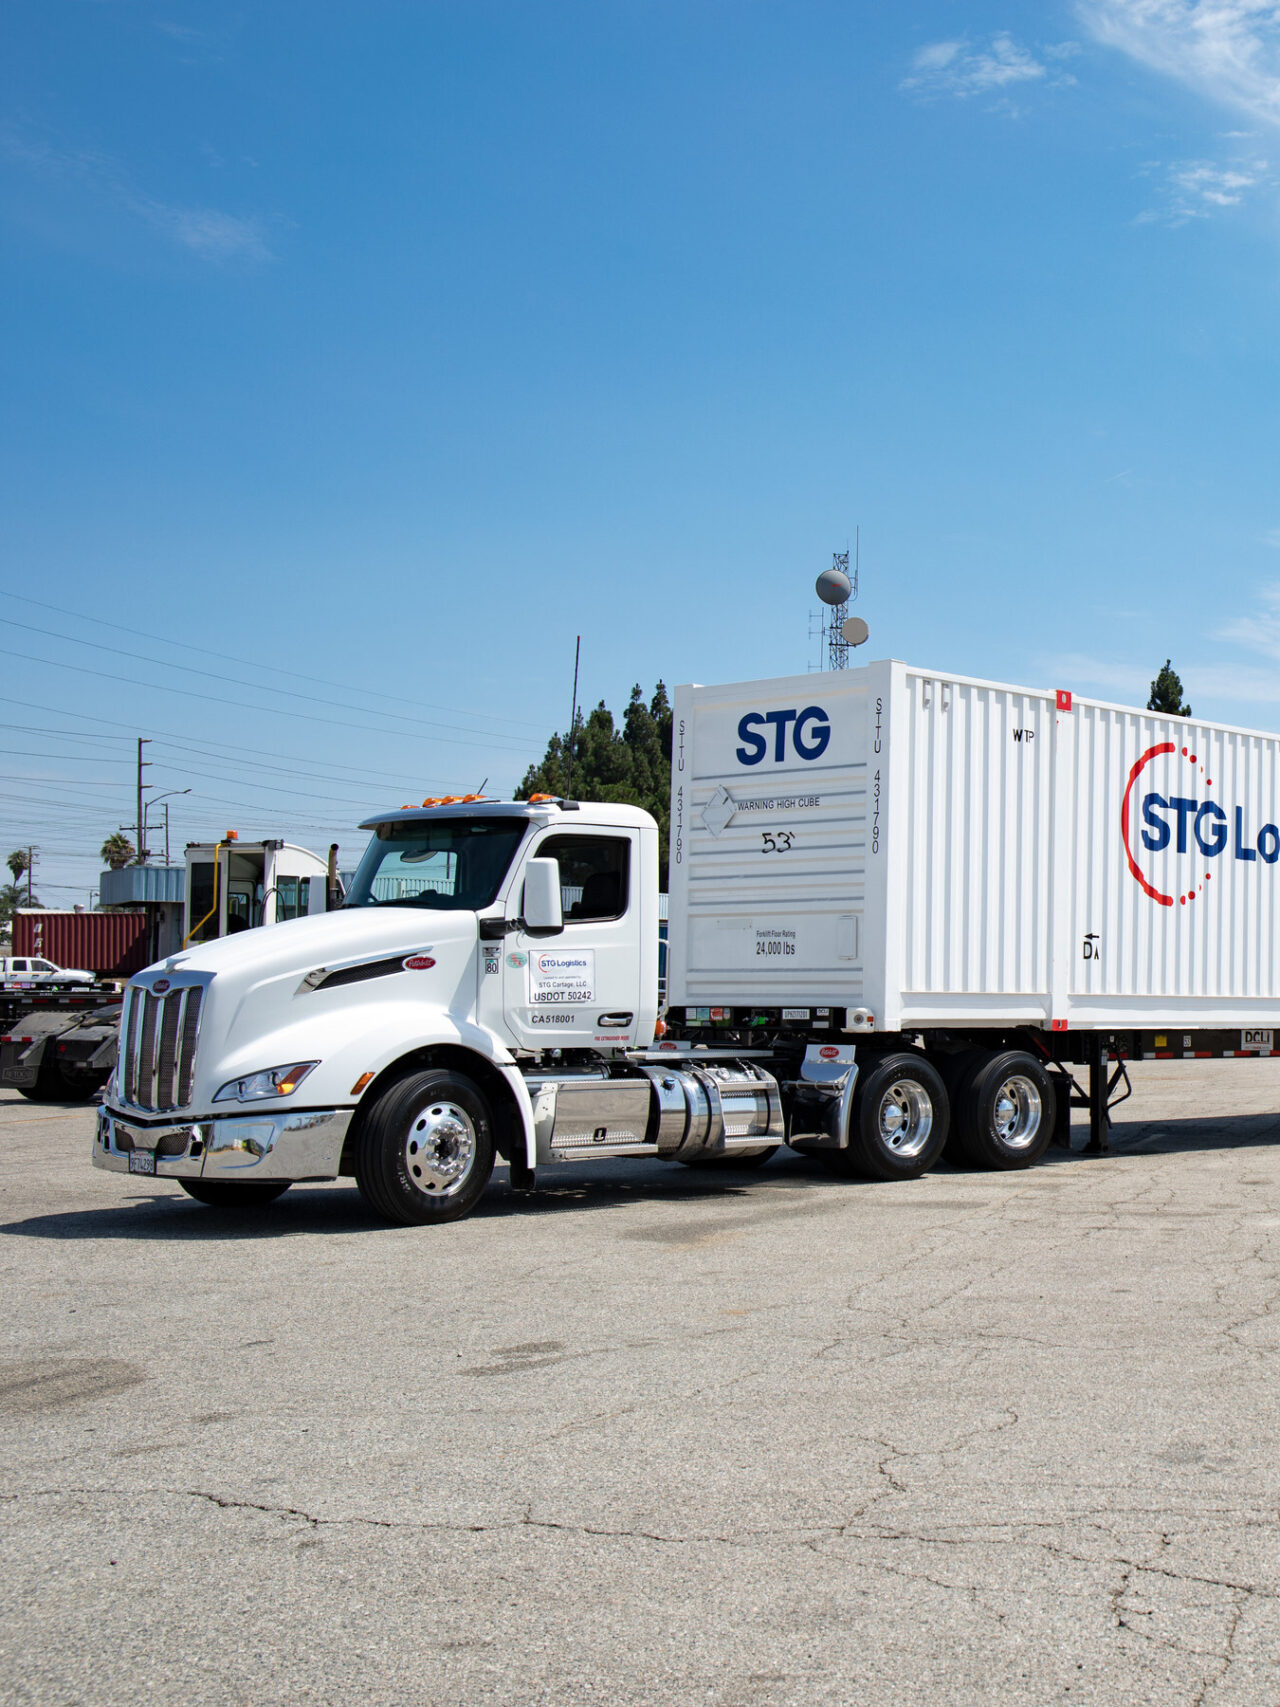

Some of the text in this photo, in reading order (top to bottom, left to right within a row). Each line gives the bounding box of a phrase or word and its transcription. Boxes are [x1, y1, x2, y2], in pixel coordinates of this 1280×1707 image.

[736, 706, 831, 766] STG
[871, 698, 882, 854] STTU 431790
[737, 796, 820, 811] WARNING HIGH CUBE
[675, 786, 683, 864] 431790
[1141, 793, 1227, 858] STG
[756, 941, 796, 957] 24,000 lbs
[486, 962, 497, 973] 80
[541, 960, 587, 968] STG Logistics
[534, 991, 592, 1001] USDOT 50242
[531, 1015, 575, 1024] CA518001
